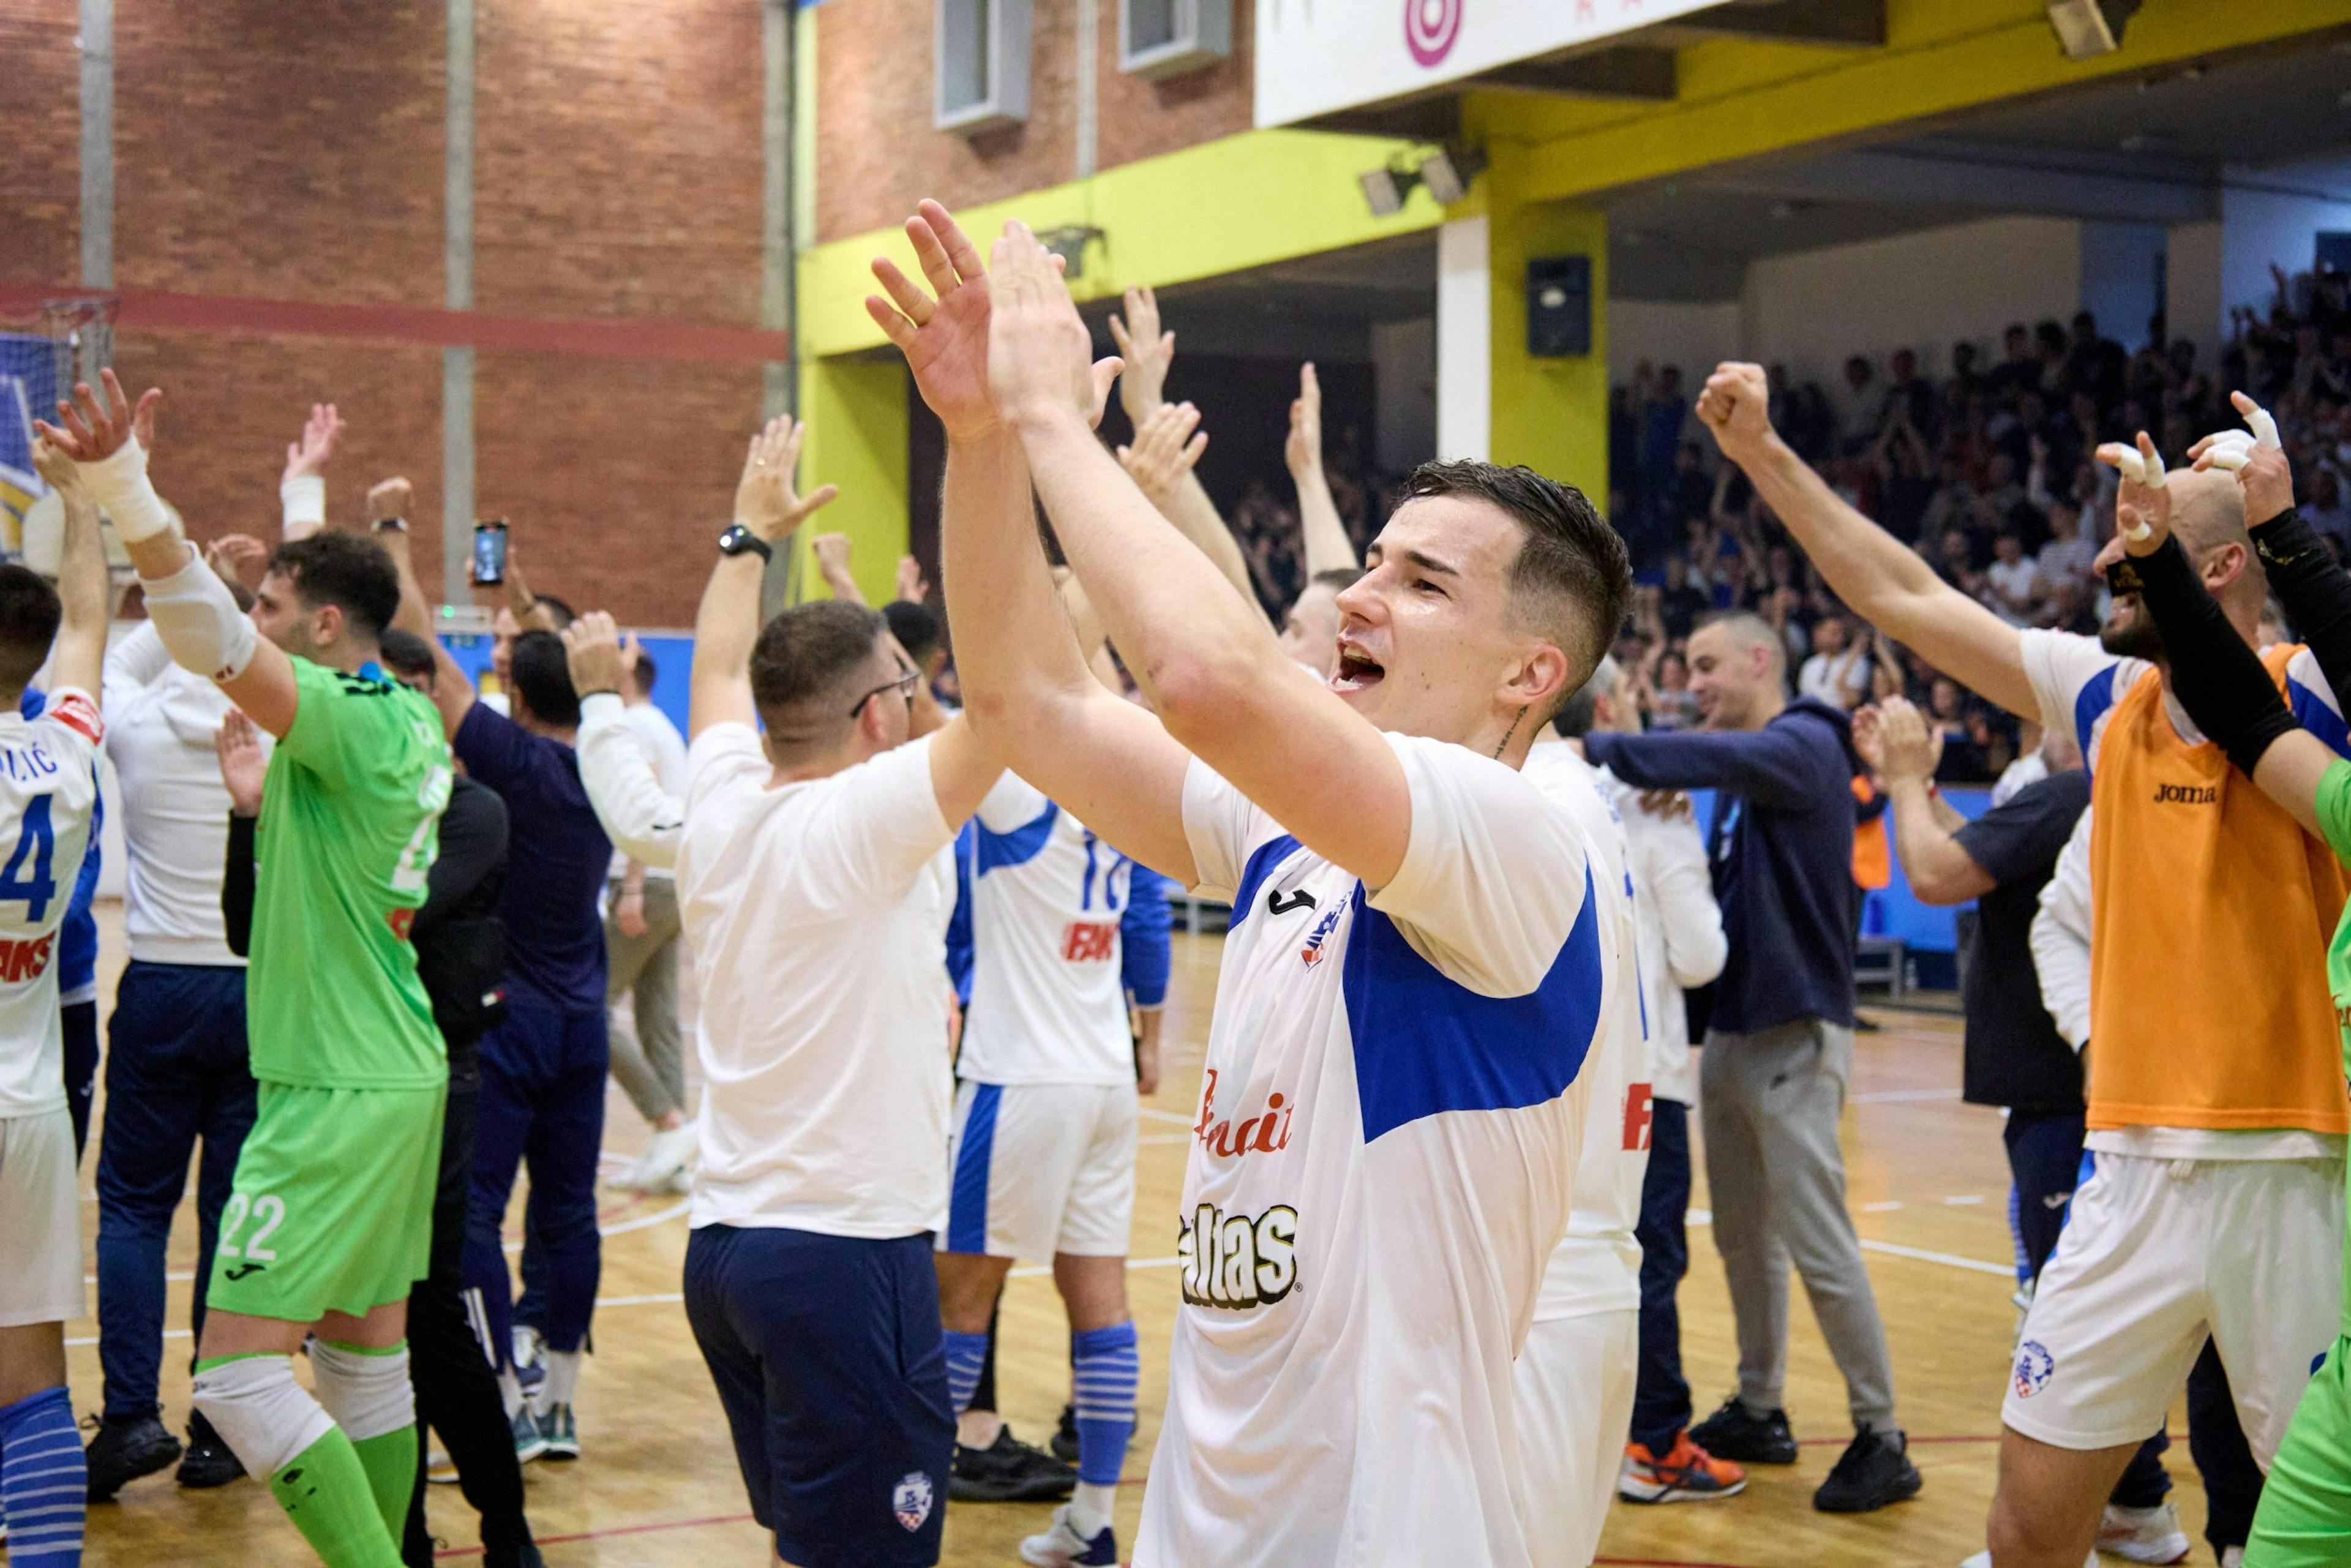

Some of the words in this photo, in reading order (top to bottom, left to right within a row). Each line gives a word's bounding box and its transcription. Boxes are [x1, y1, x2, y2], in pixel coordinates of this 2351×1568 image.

[0, 741, 57, 780] LIĆ
[2154, 784, 2216, 804] Joma
[218, 1193, 285, 1261] 22
